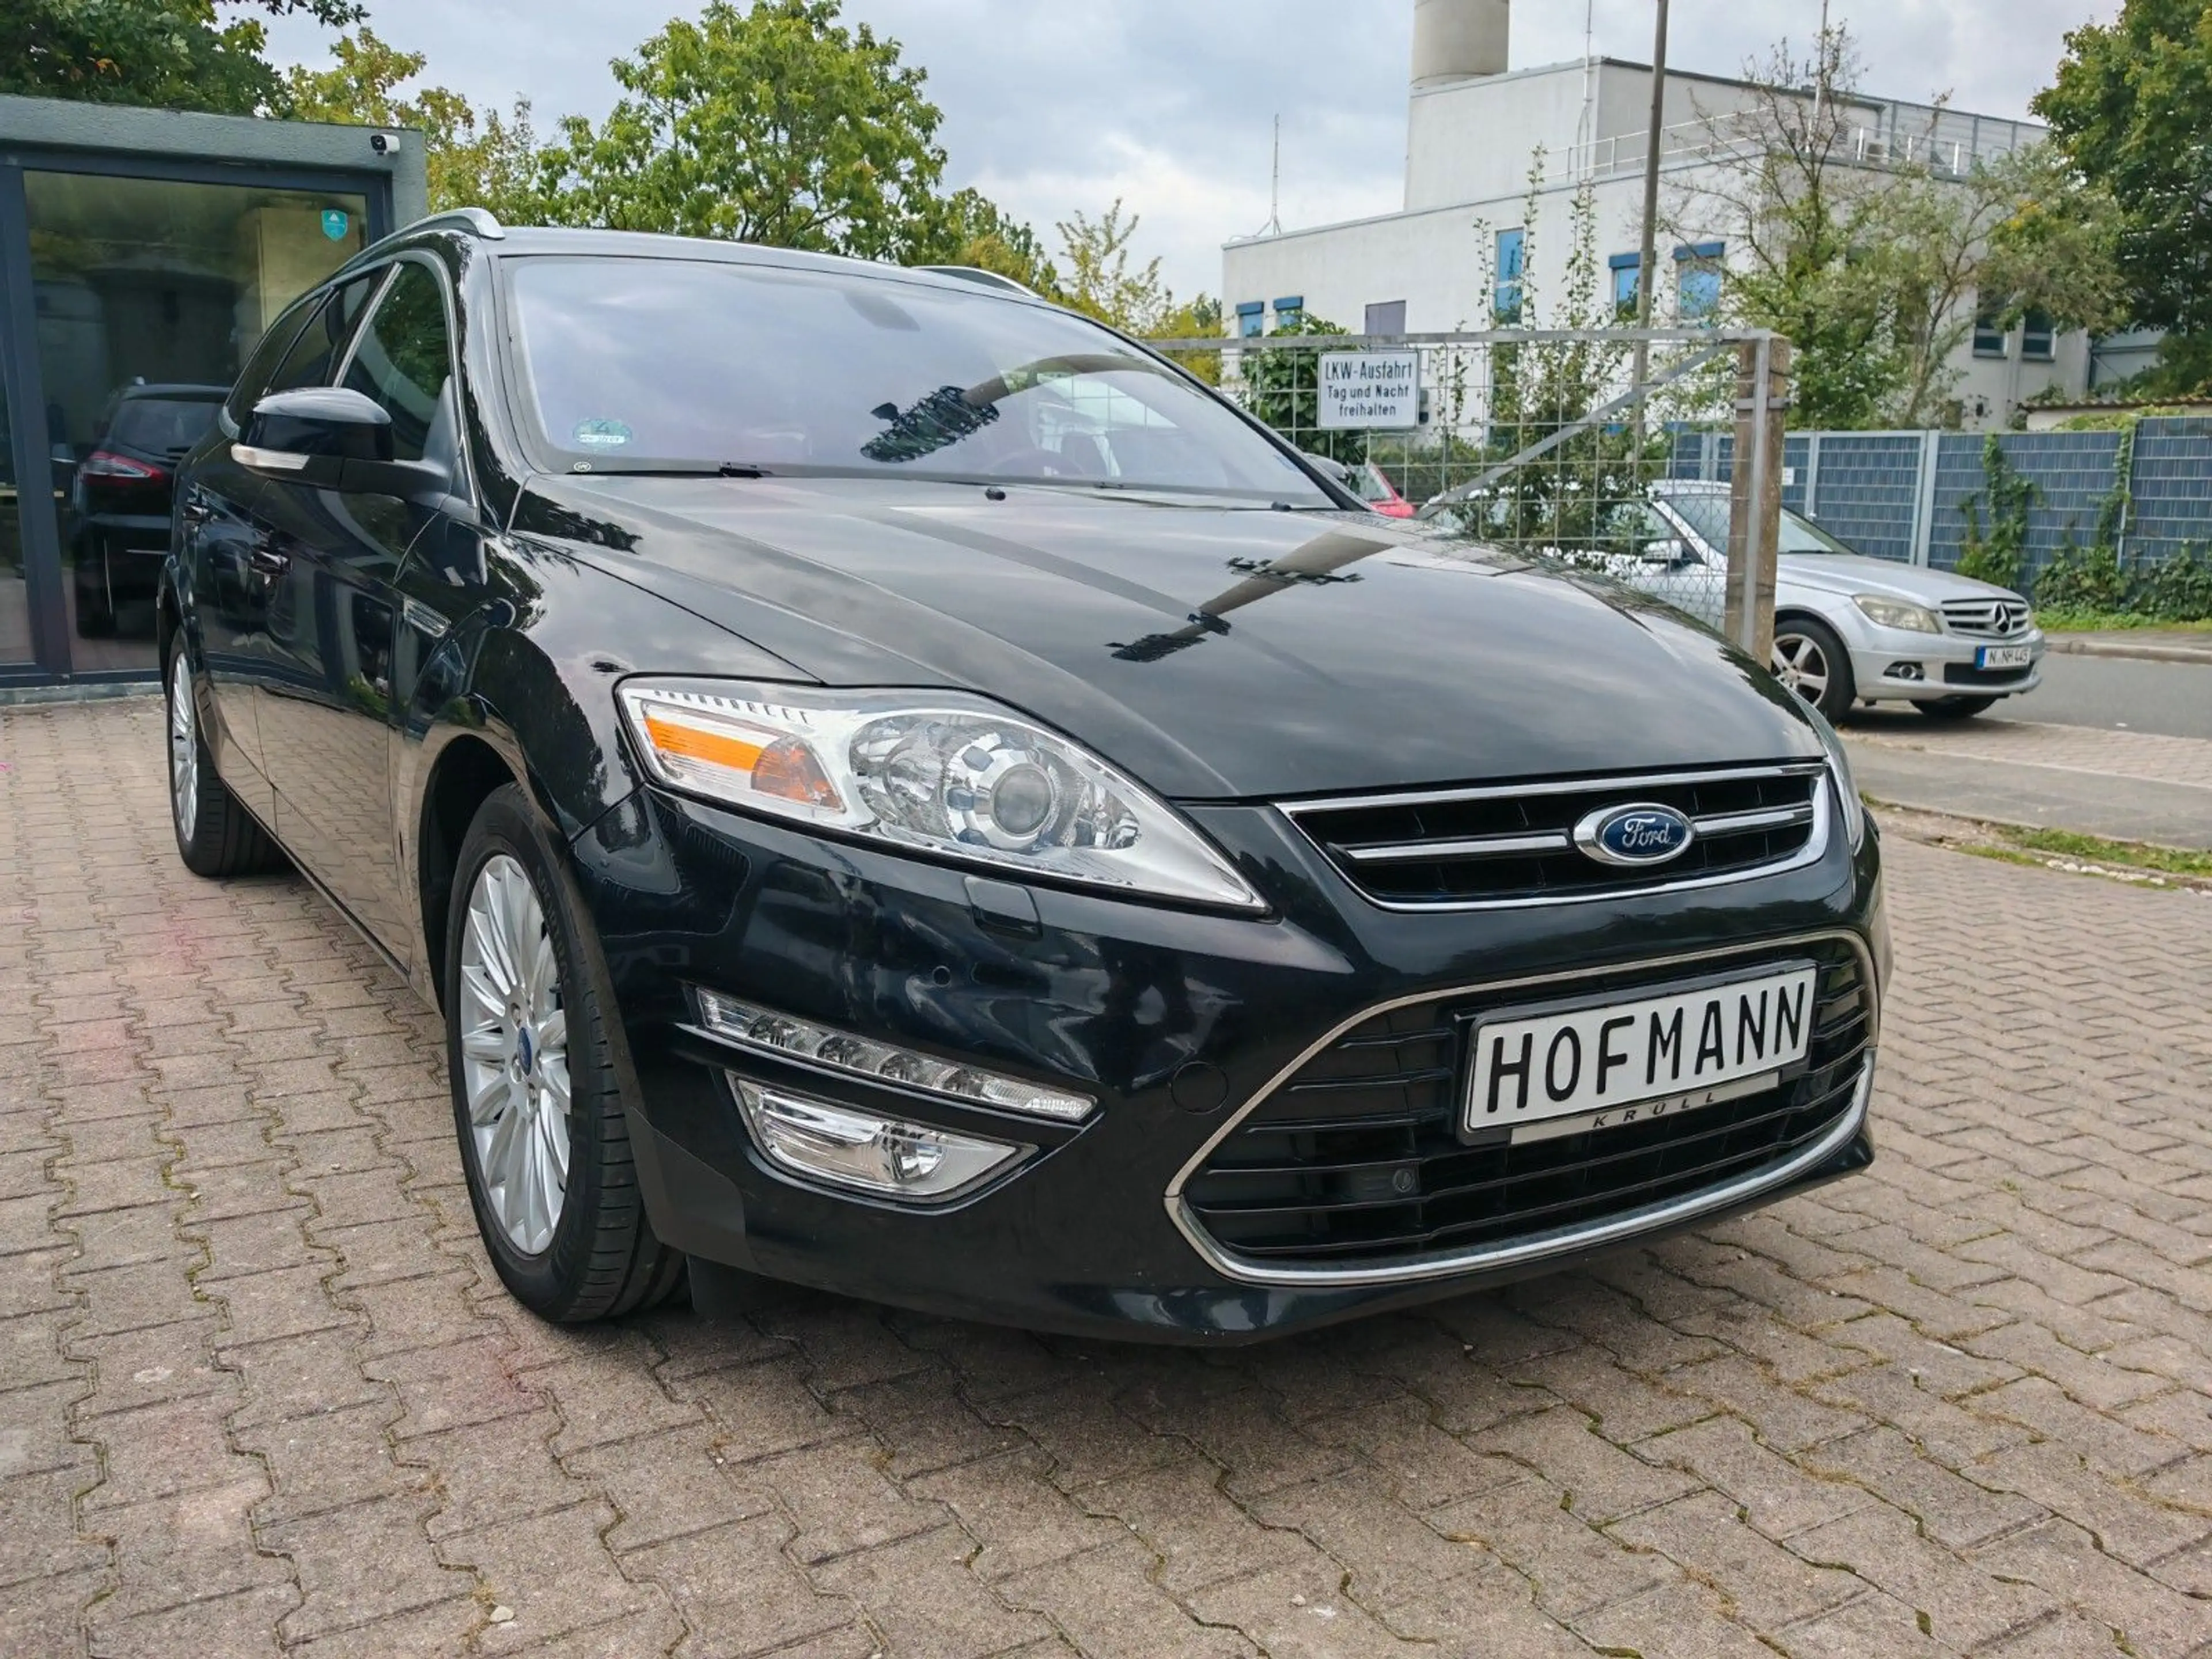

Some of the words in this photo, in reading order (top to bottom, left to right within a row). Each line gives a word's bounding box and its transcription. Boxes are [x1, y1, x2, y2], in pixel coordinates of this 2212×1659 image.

[1325, 361, 1412, 380] LKW-Ausfahrt
[1328, 385, 1346, 402] Tag
[1350, 385, 1371, 399] und
[1376, 384, 1409, 398] Nacht
[1339, 403, 1396, 417] freihalten
[1622, 817, 1671, 849] Ford
[1487, 982, 1805, 1113] HOFMANN
